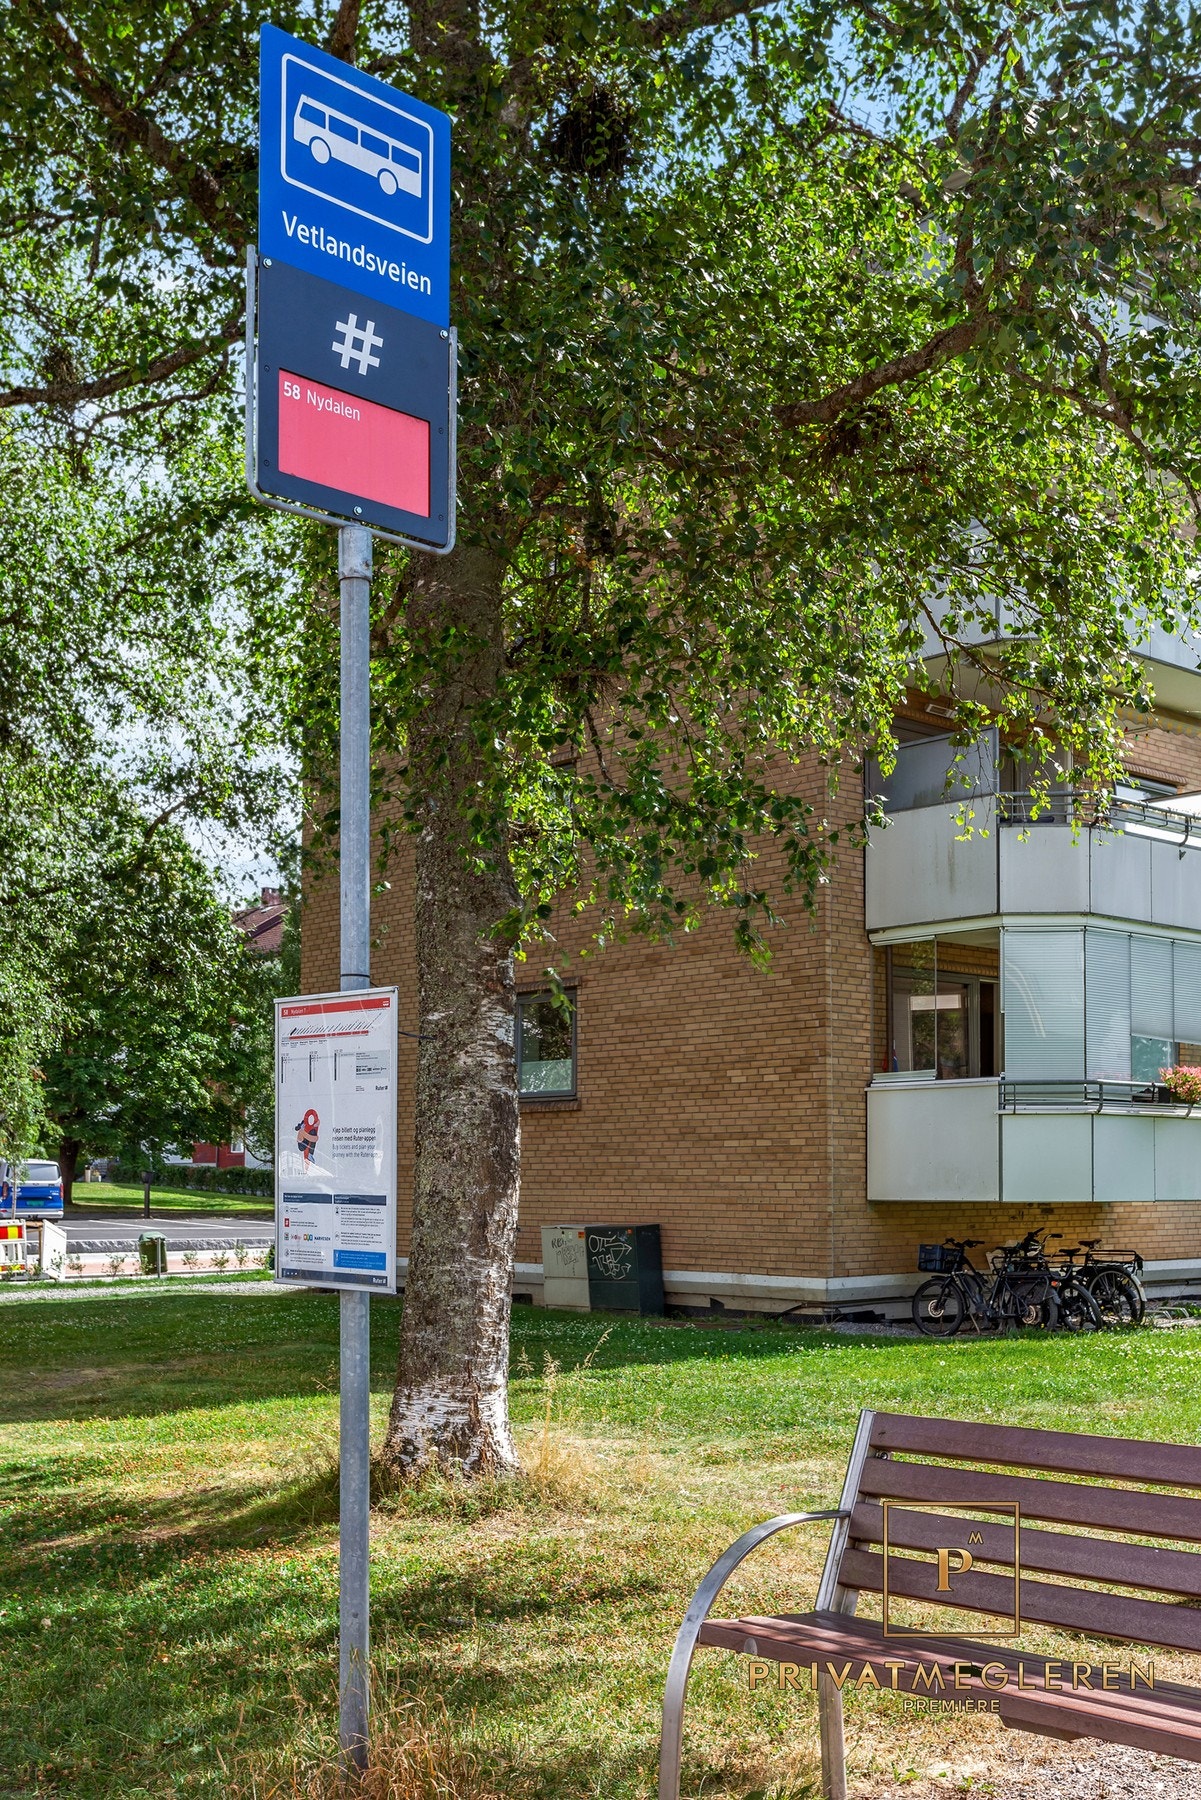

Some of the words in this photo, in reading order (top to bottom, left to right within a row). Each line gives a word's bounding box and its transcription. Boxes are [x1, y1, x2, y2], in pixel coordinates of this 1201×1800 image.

[282, 210, 432, 295] Vetlandsveien
[283, 381, 301, 400] 58
[306, 389, 361, 421] Nydalen
